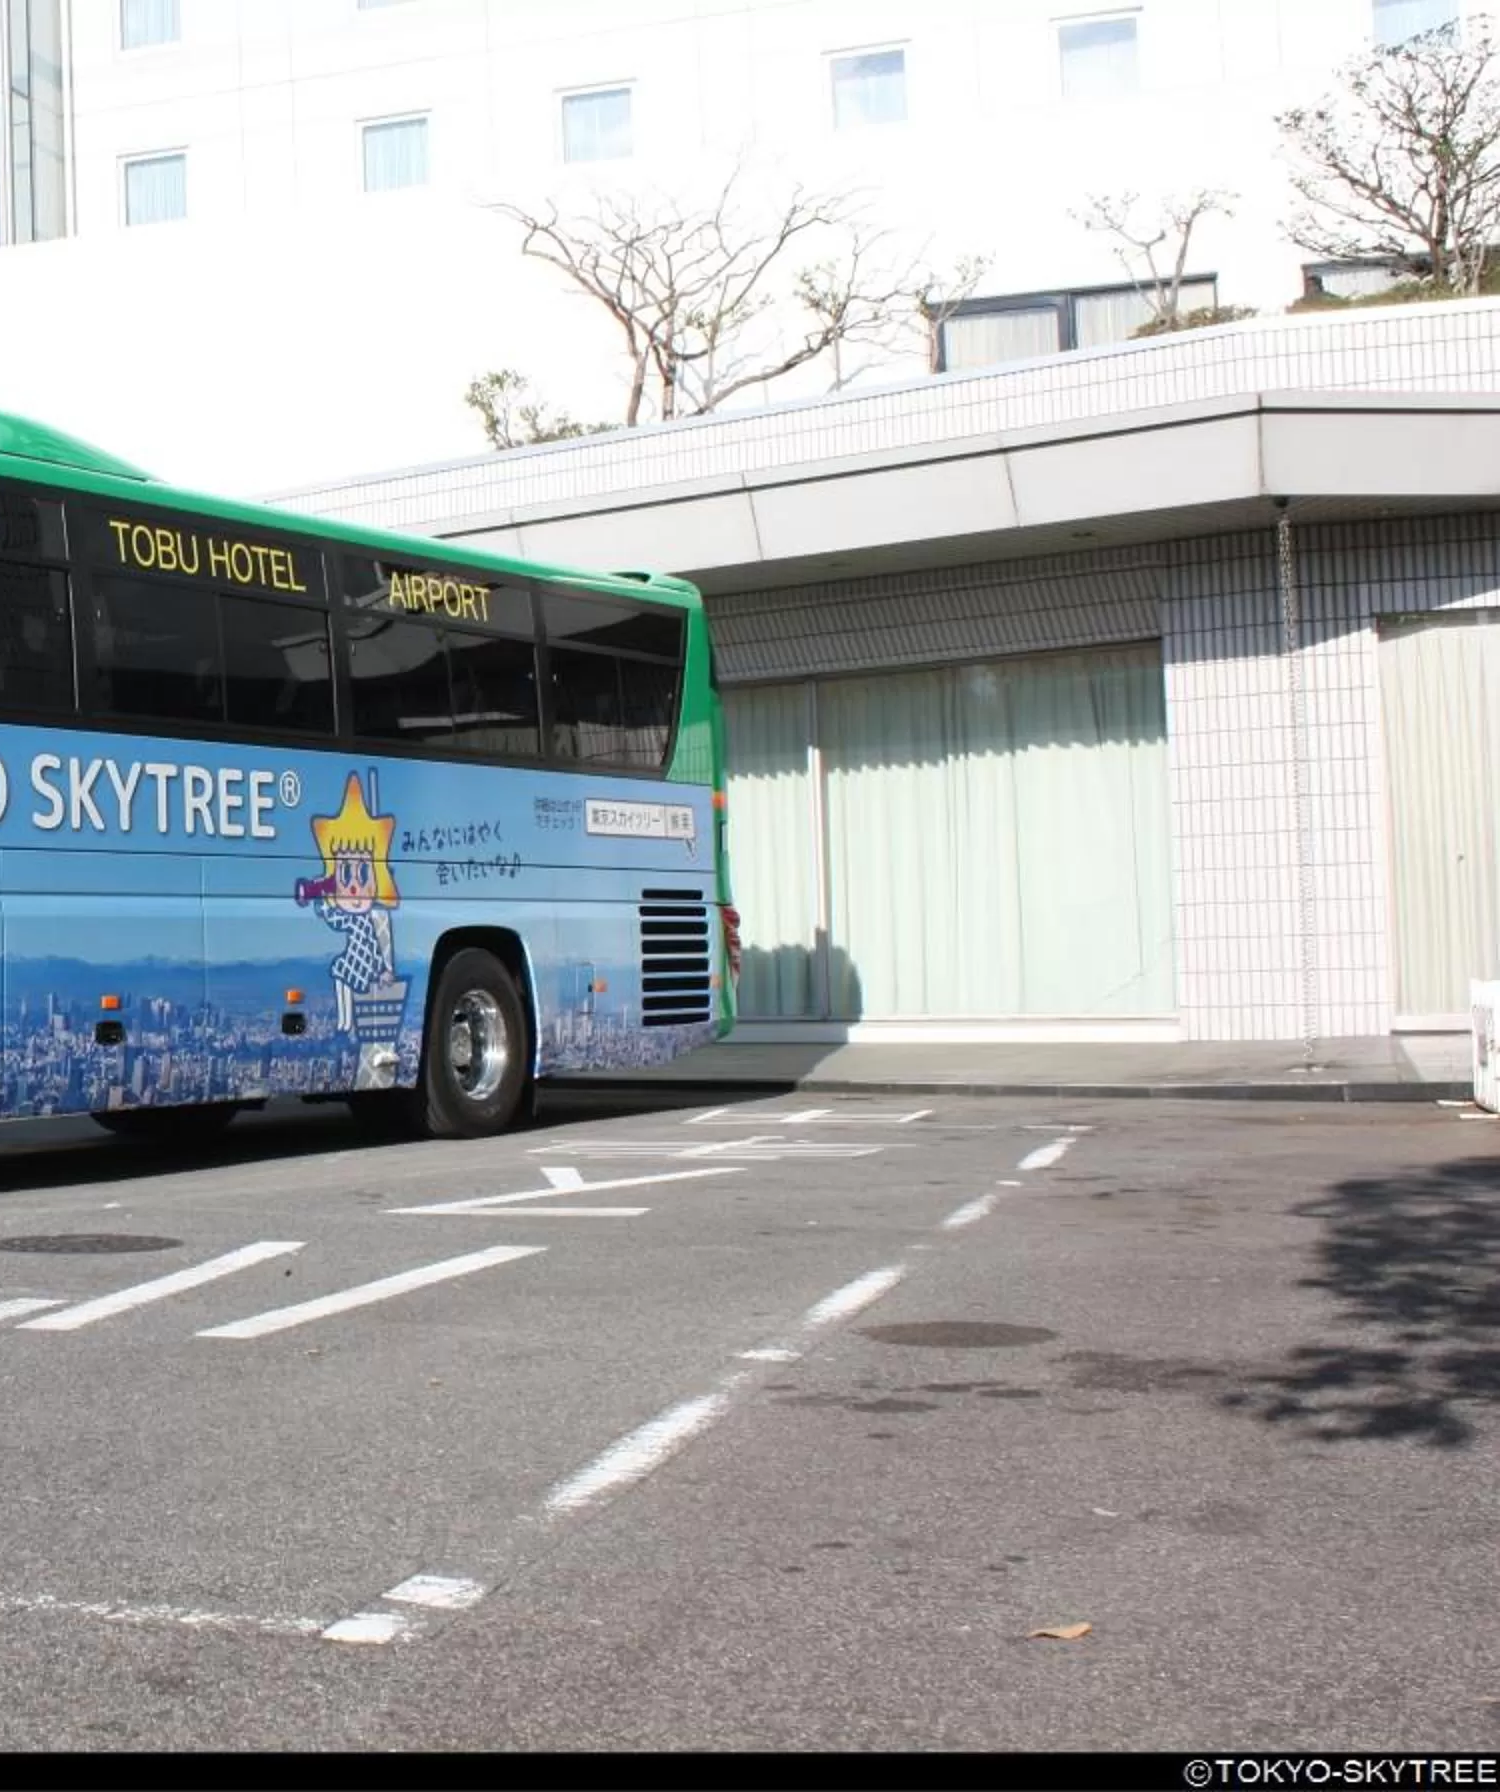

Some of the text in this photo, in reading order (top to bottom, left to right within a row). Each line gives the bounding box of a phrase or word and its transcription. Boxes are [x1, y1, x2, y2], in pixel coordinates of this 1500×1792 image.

[109, 521, 306, 593] TOBU HOTEL
[388, 571, 491, 623] AIRPORT
